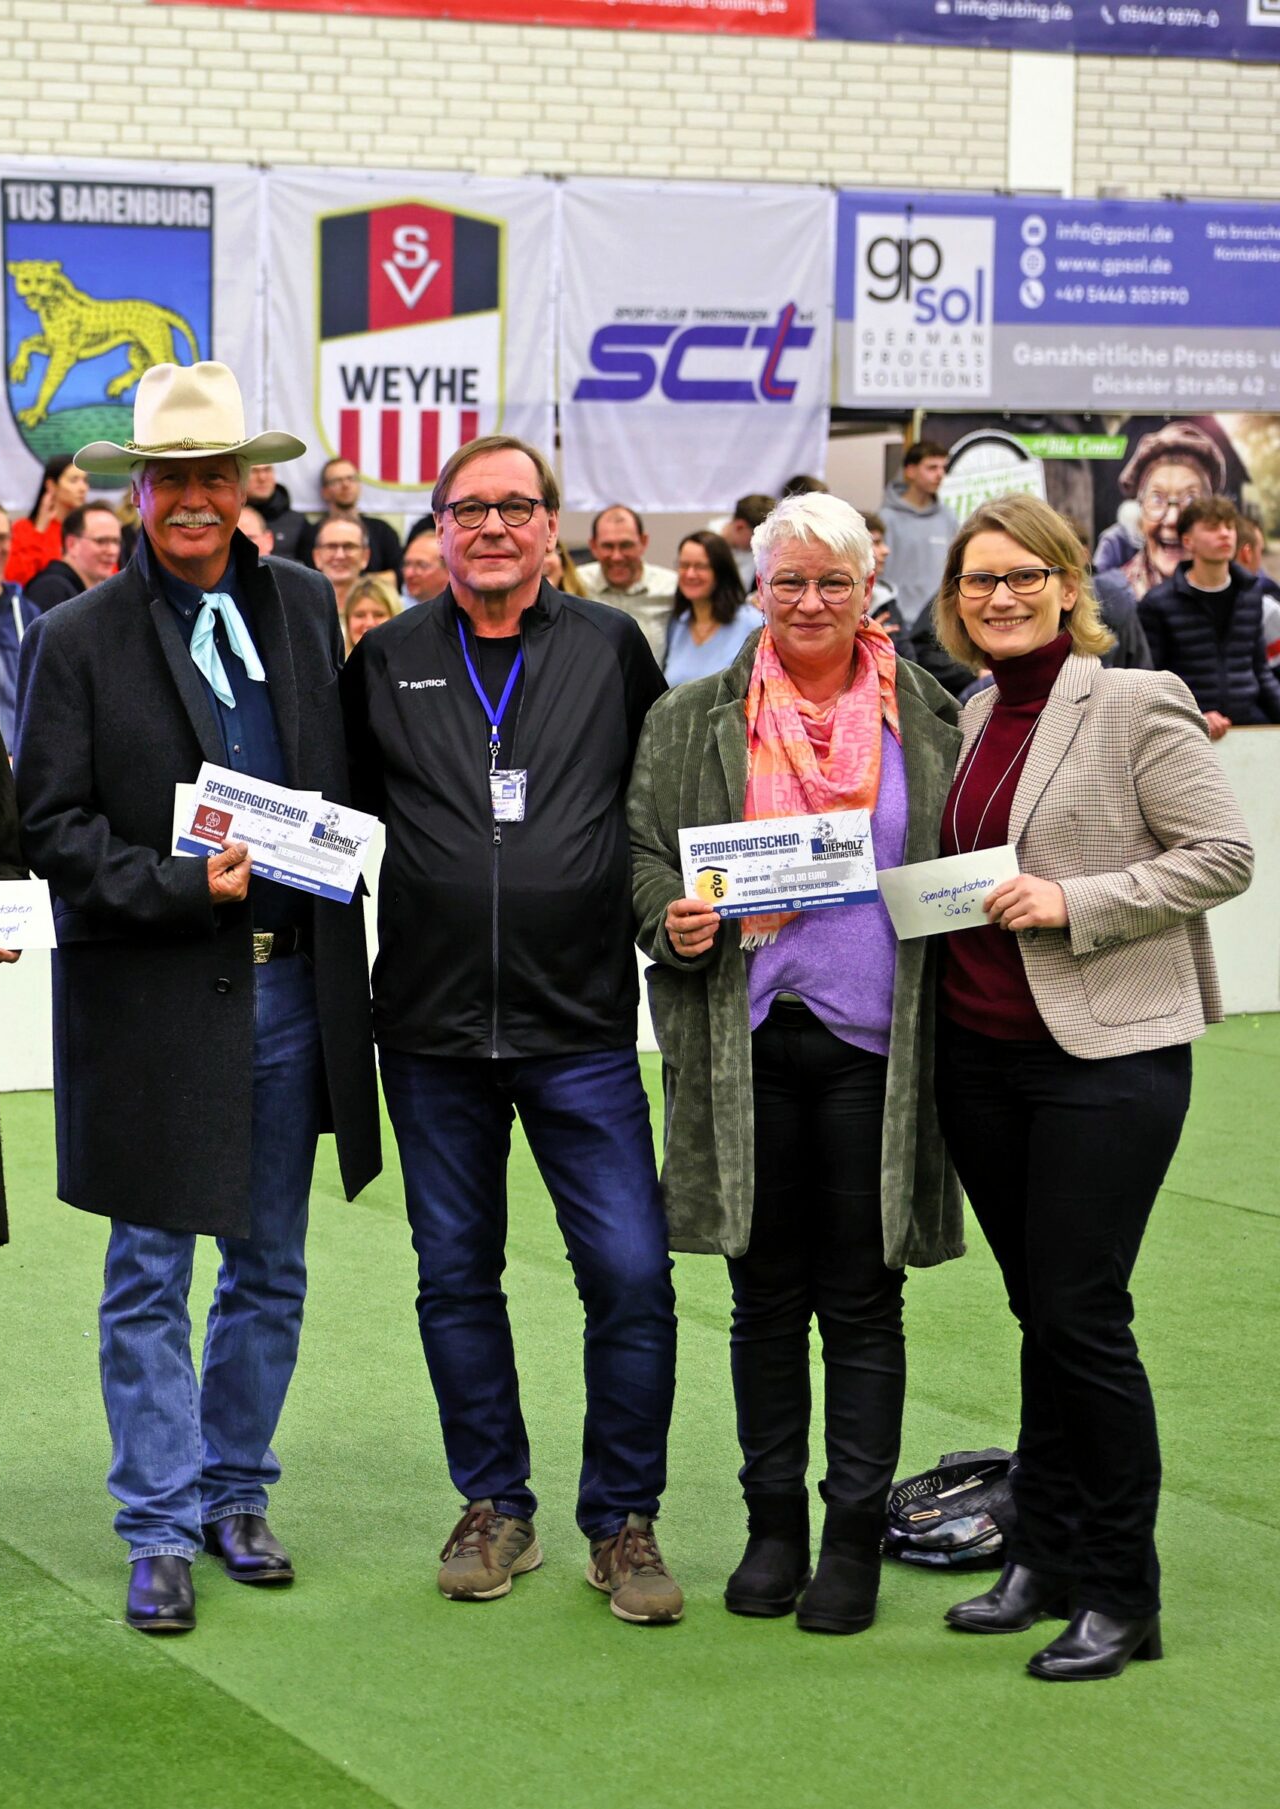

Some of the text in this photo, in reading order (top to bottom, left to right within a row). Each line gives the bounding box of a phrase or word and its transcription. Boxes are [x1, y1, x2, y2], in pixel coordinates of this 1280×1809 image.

[5, 183, 211, 227] TUS BARENBURG
[1055, 221, 1174, 245] info@gpsol.de
[1213, 245, 1280, 263] Kontaktie
[1055, 254, 1172, 277] www.gpsol.de
[862, 330, 984, 346] GERMAN
[862, 351, 984, 367] PROCESS
[1012, 341, 1169, 367] Ganzheitliche
[339, 364, 479, 404] WEYHE
[862, 371, 984, 388] SOLUTIONS
[1092, 373, 1171, 396] Dickeler
[410, 677, 447, 691] PATRICK
[204, 780, 308, 823] SPENDENGUTSCHEIN
[322, 831, 362, 851] DIEPHOLZ
[690, 832, 800, 857] SPENDENGUTSCHEIN
[821, 840, 863, 853] DIEPHOLZ
[812, 850, 864, 862] HALLENMASTERS
